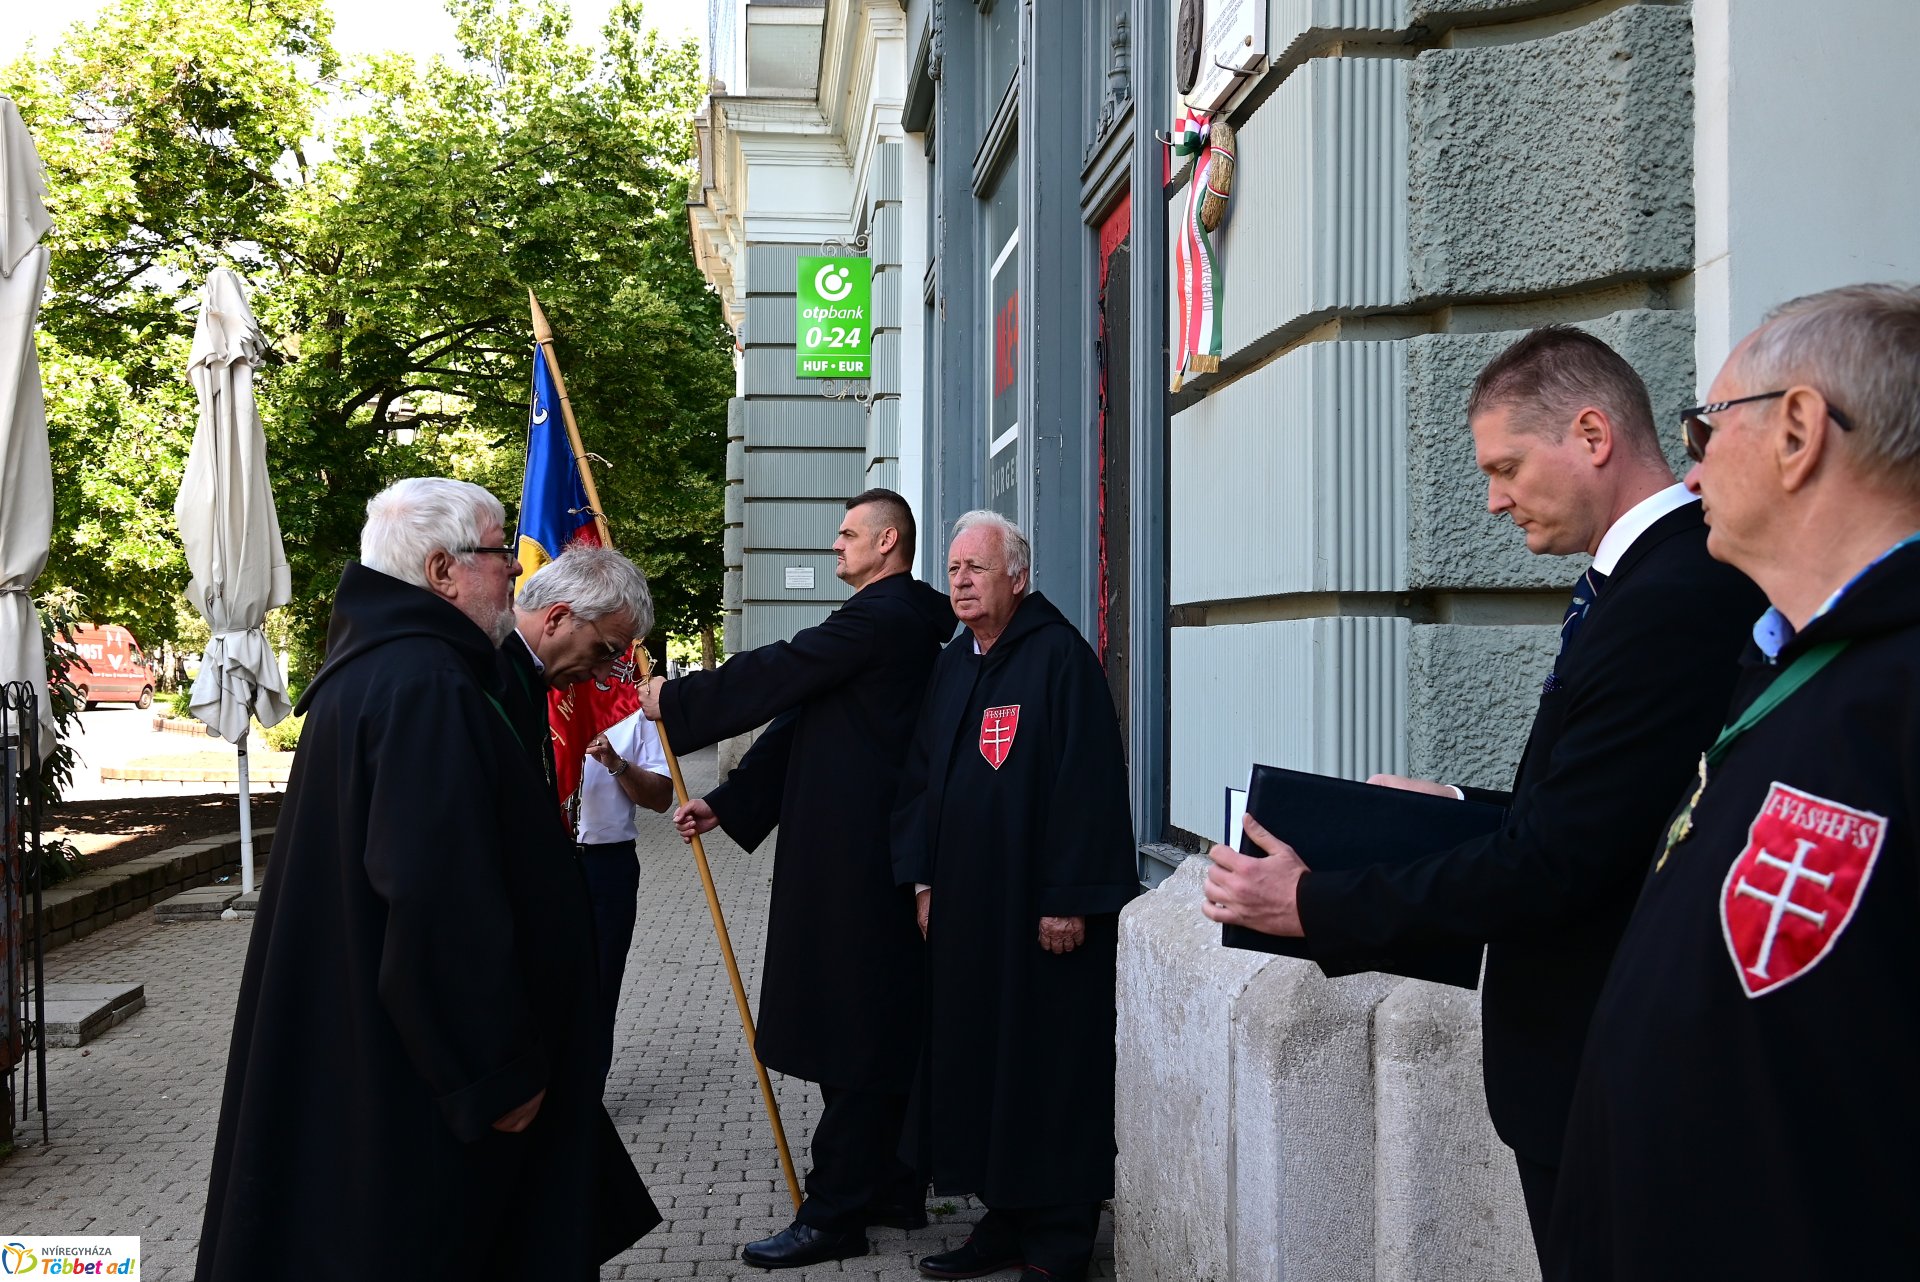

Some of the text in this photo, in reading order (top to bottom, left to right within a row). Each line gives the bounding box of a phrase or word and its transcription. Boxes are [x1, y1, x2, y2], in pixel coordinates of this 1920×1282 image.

[803, 305, 864, 322] otpbank
[805, 327, 861, 348] 0-24
[803, 361, 864, 372] HUF EUR
